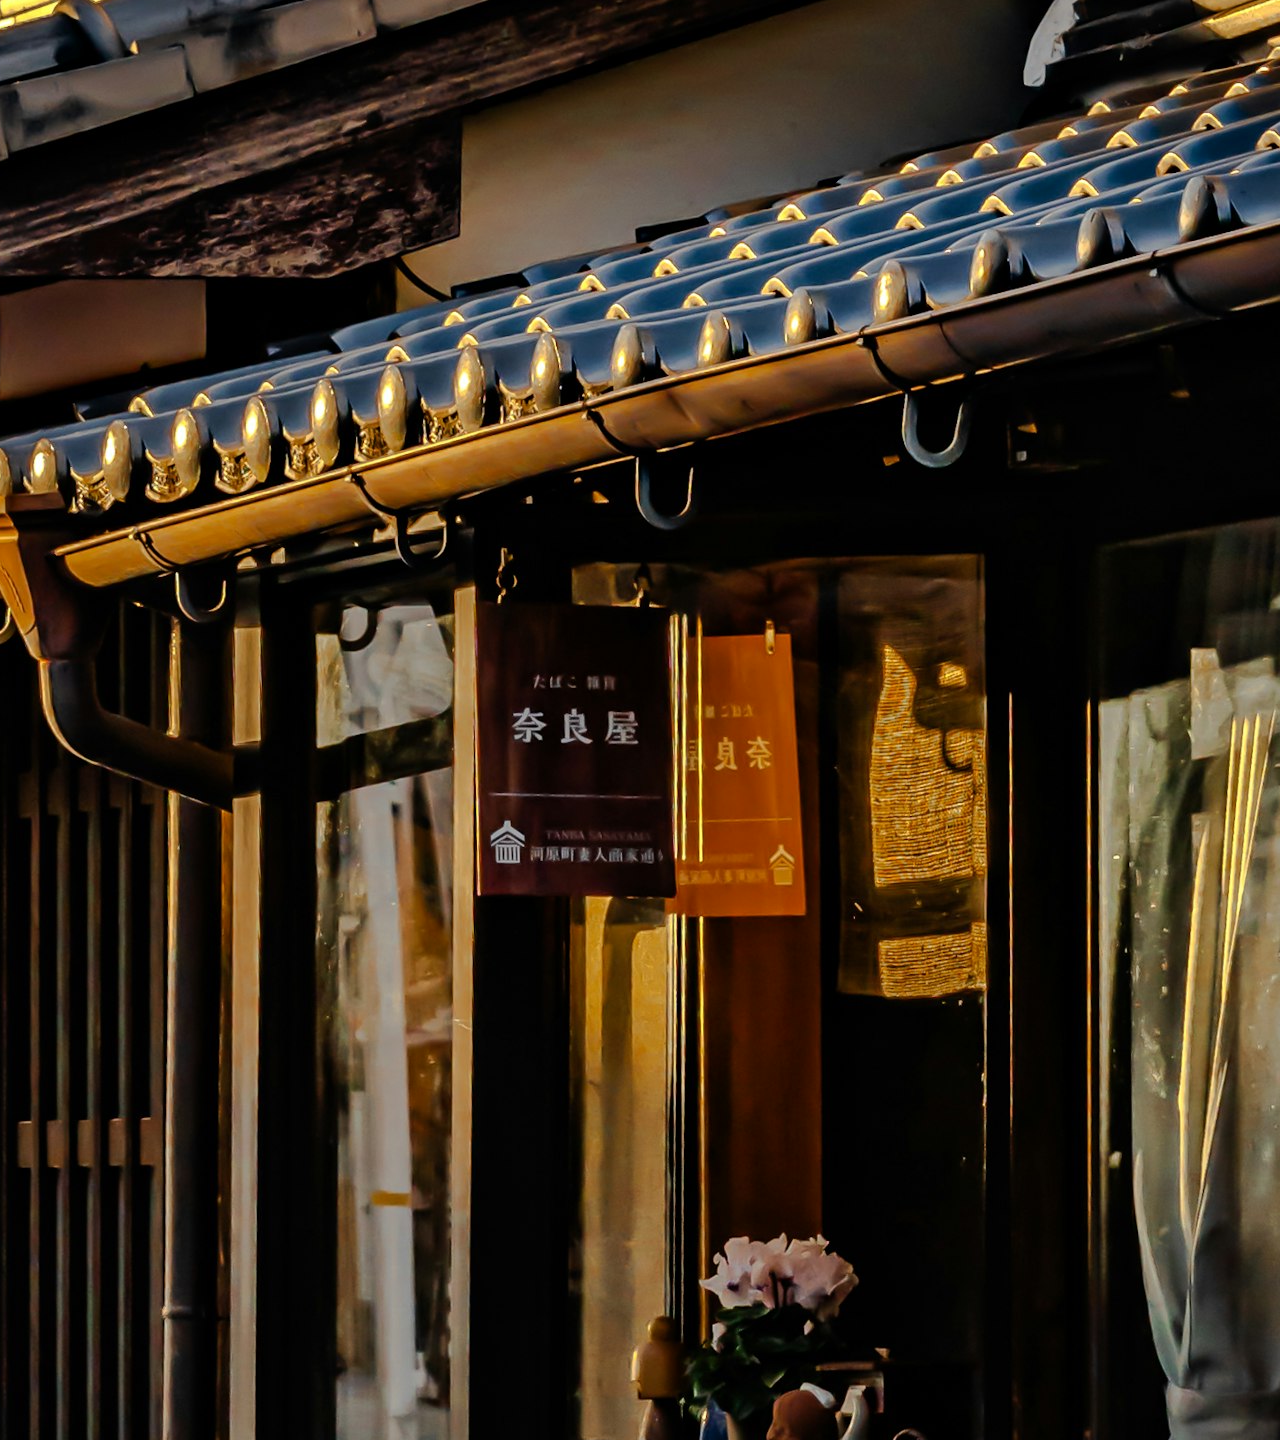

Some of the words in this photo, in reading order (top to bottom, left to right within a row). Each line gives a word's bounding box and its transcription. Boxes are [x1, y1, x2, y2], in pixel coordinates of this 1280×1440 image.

[533, 674, 577, 689] たばこ
[512, 707, 639, 745] 奈良屋
